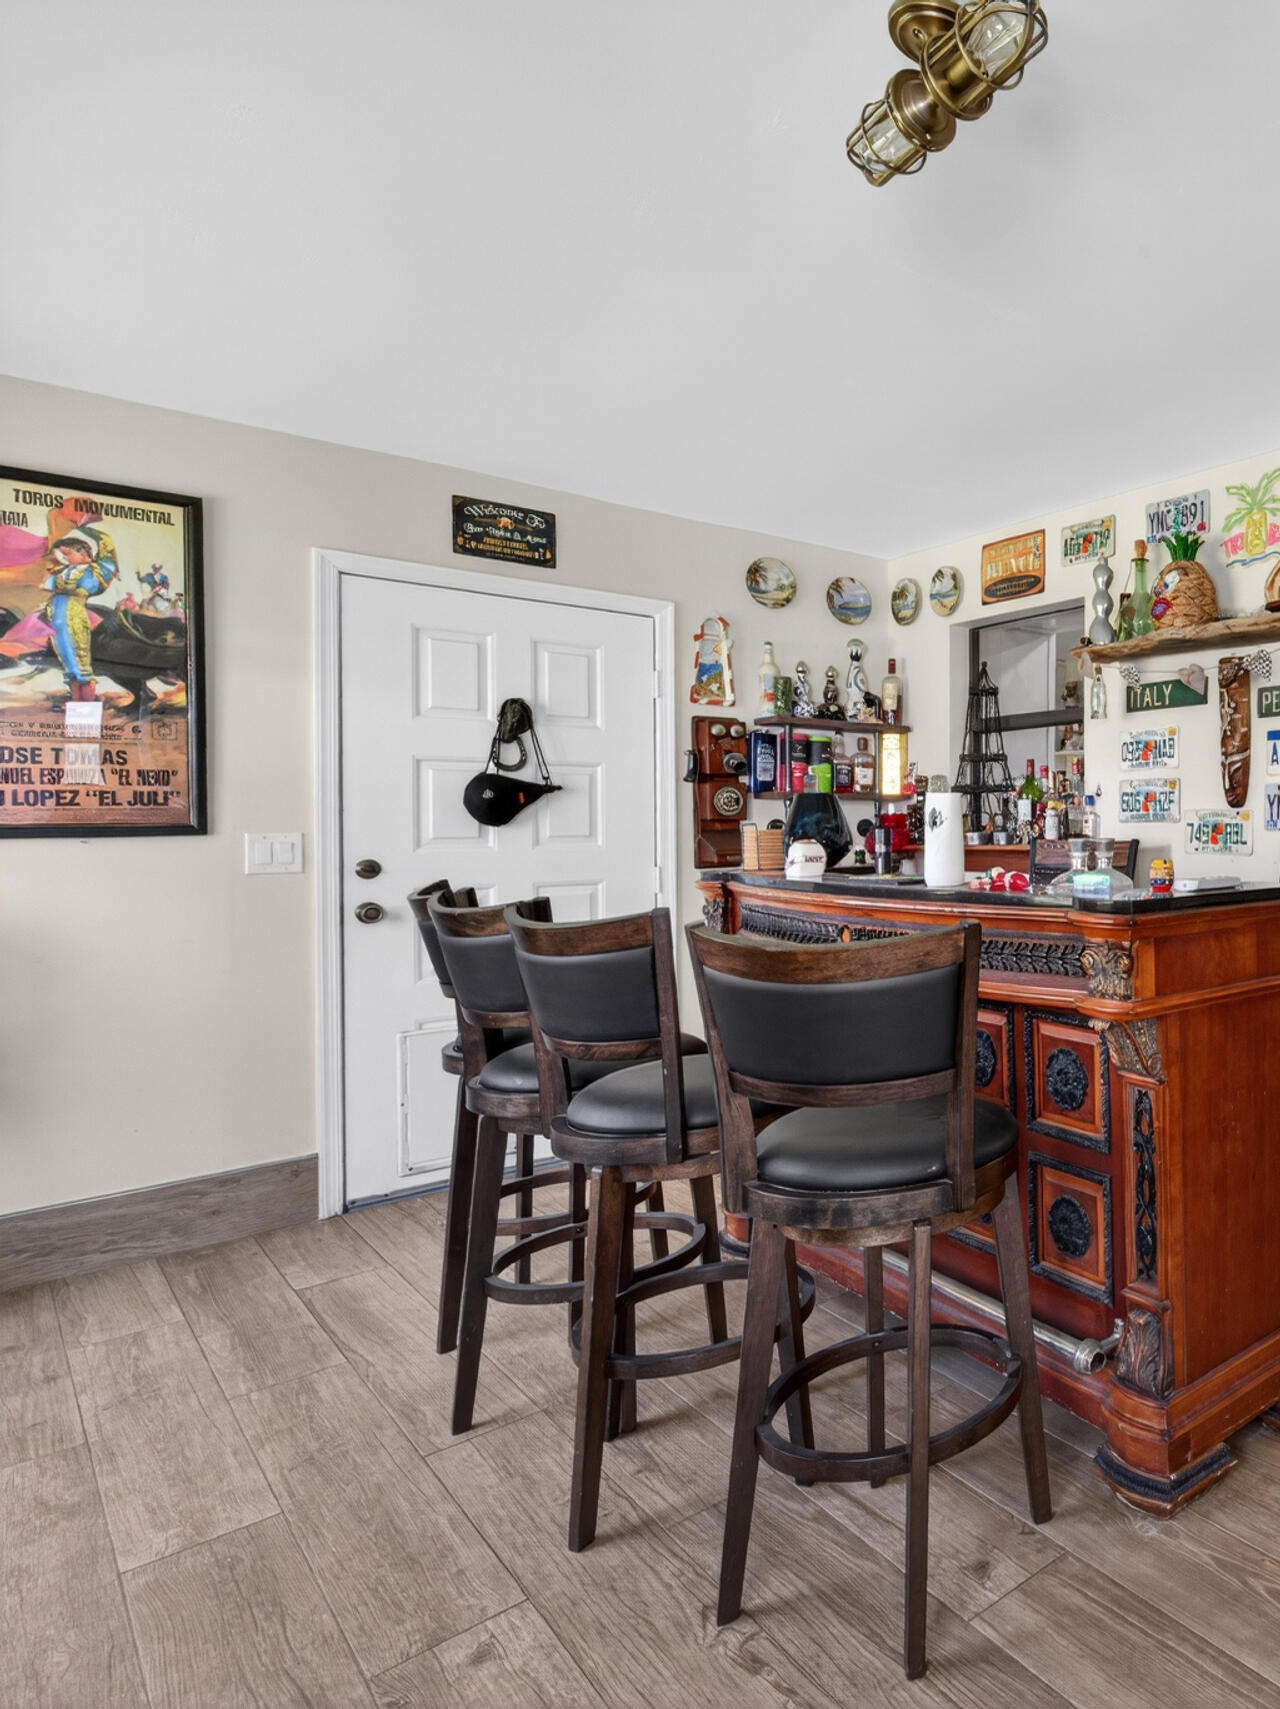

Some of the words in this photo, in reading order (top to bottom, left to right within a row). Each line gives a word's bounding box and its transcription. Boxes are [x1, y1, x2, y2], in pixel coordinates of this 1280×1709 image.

[13, 488, 64, 509] TOROS
[74, 498, 175, 526] MONUMENTAL
[1130, 684, 1173, 709] ITALY
[11, 789, 80, 807] LOPEZ
